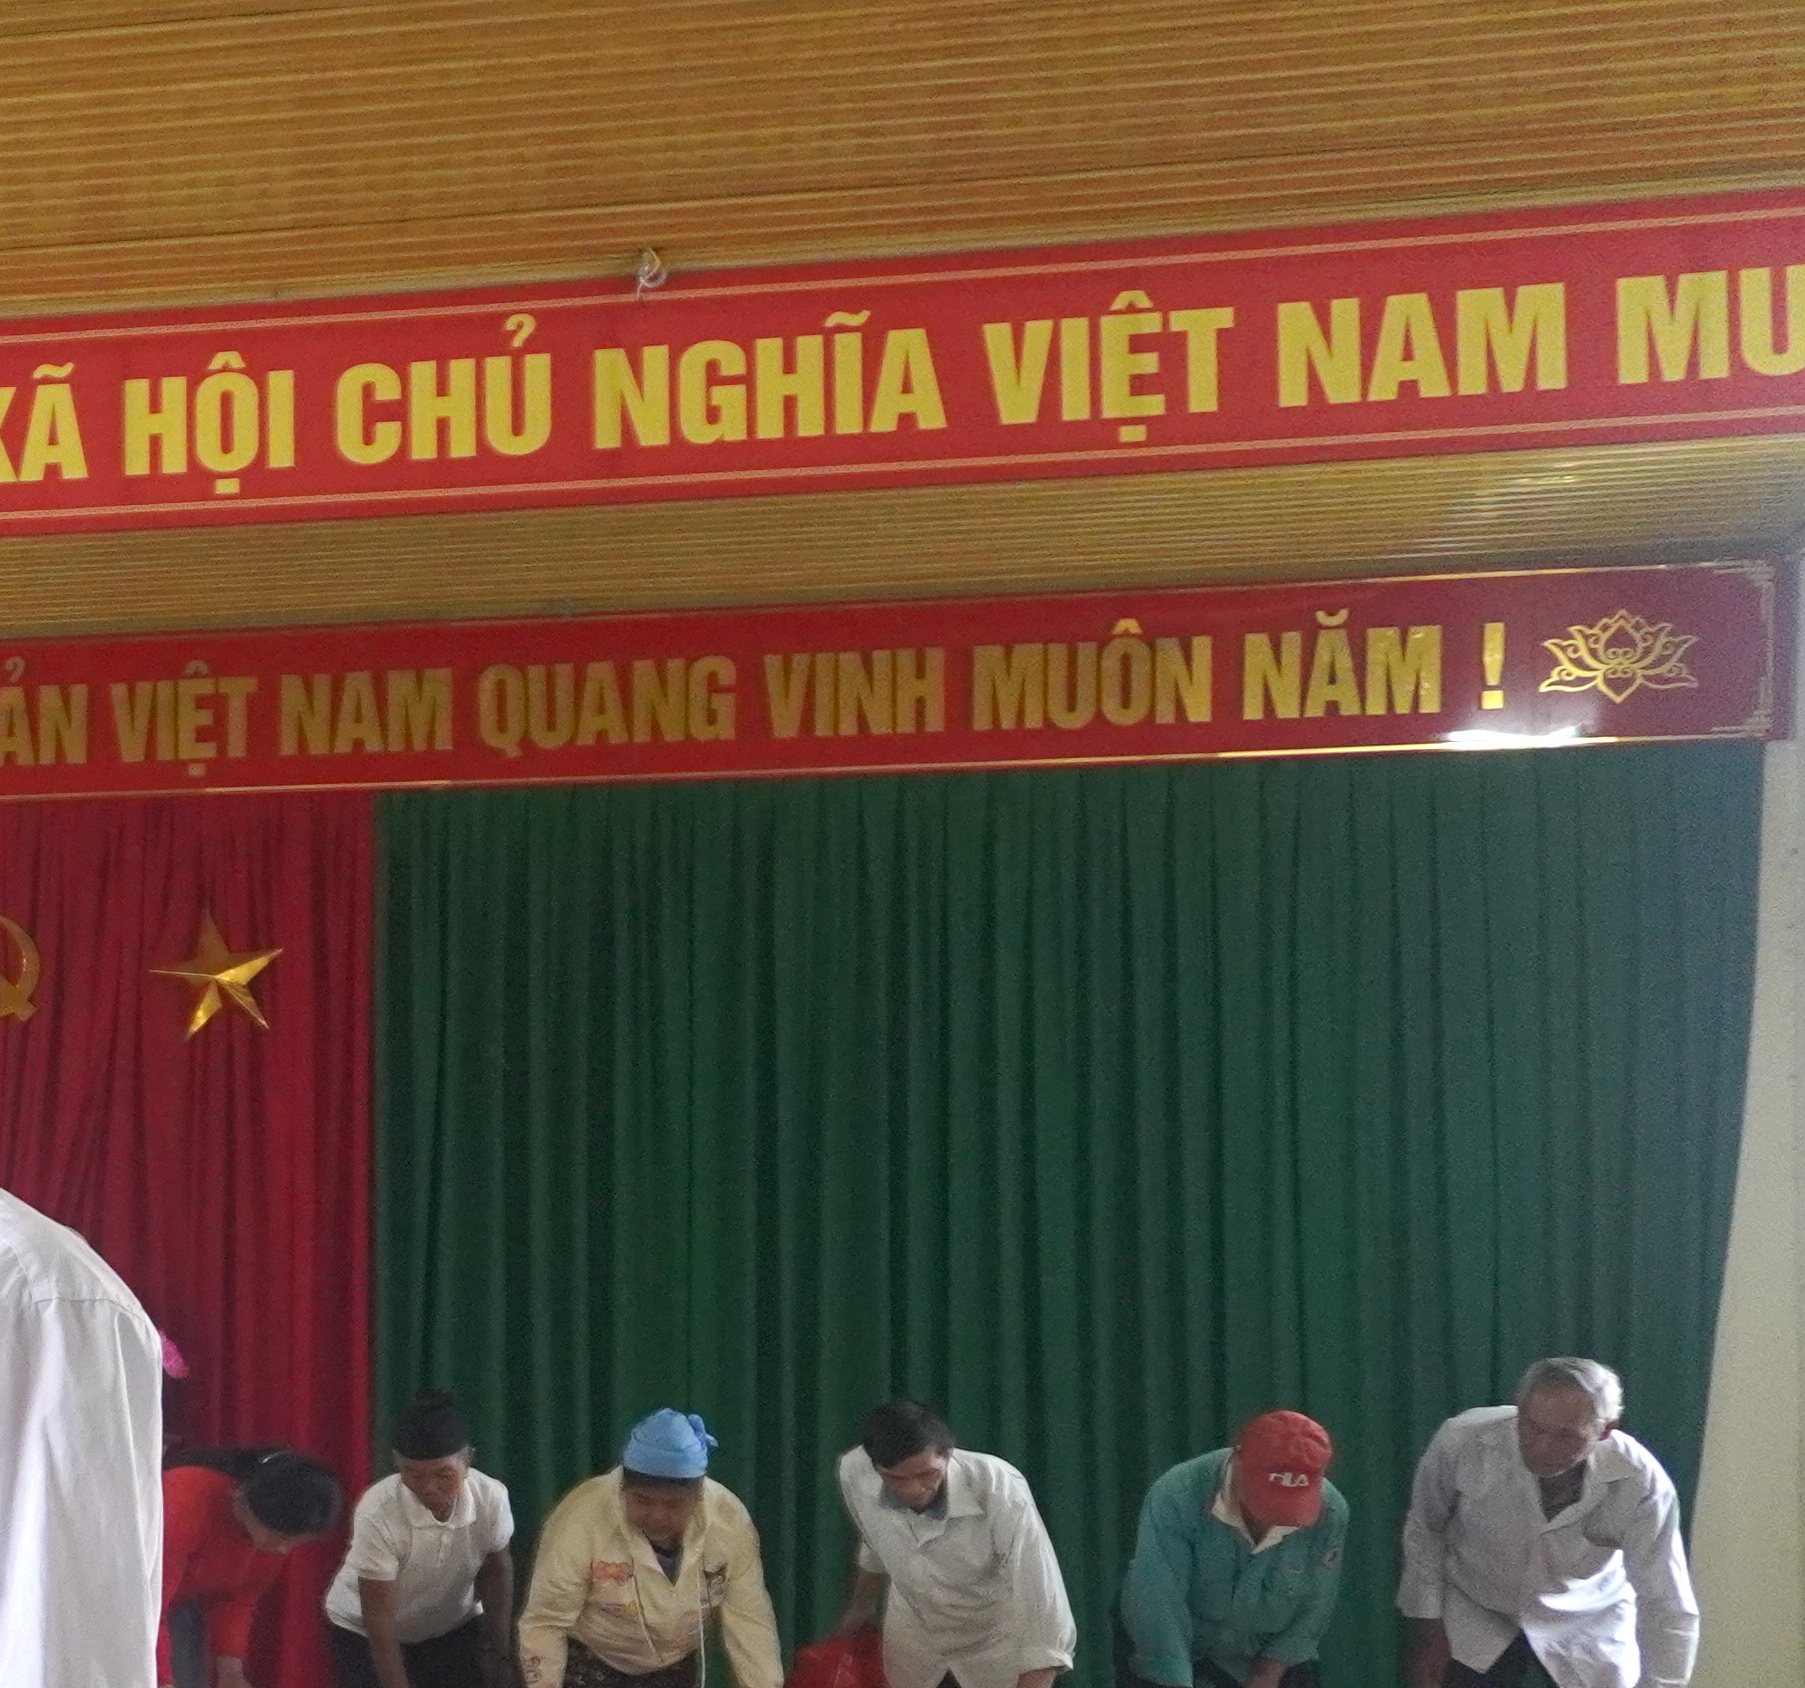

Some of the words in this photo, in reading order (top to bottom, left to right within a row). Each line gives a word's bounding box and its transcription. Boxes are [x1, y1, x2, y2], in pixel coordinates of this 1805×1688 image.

[122, 350, 296, 493] HỘI
[334, 314, 553, 465] CHỦ
[592, 311, 948, 450] NGHĨA
[982, 290, 1236, 443] VIỆT
[1277, 282, 1568, 408] NAM
[111, 659, 259, 777] VIỆT
[279, 667, 454, 758] NAM
[478, 655, 738, 759] QUANG
[764, 646, 946, 739] VINH
[971, 617, 1214, 731] MUÔN
[1241, 609, 1445, 722] NĂM
[1478, 622, 1507, 712] !
